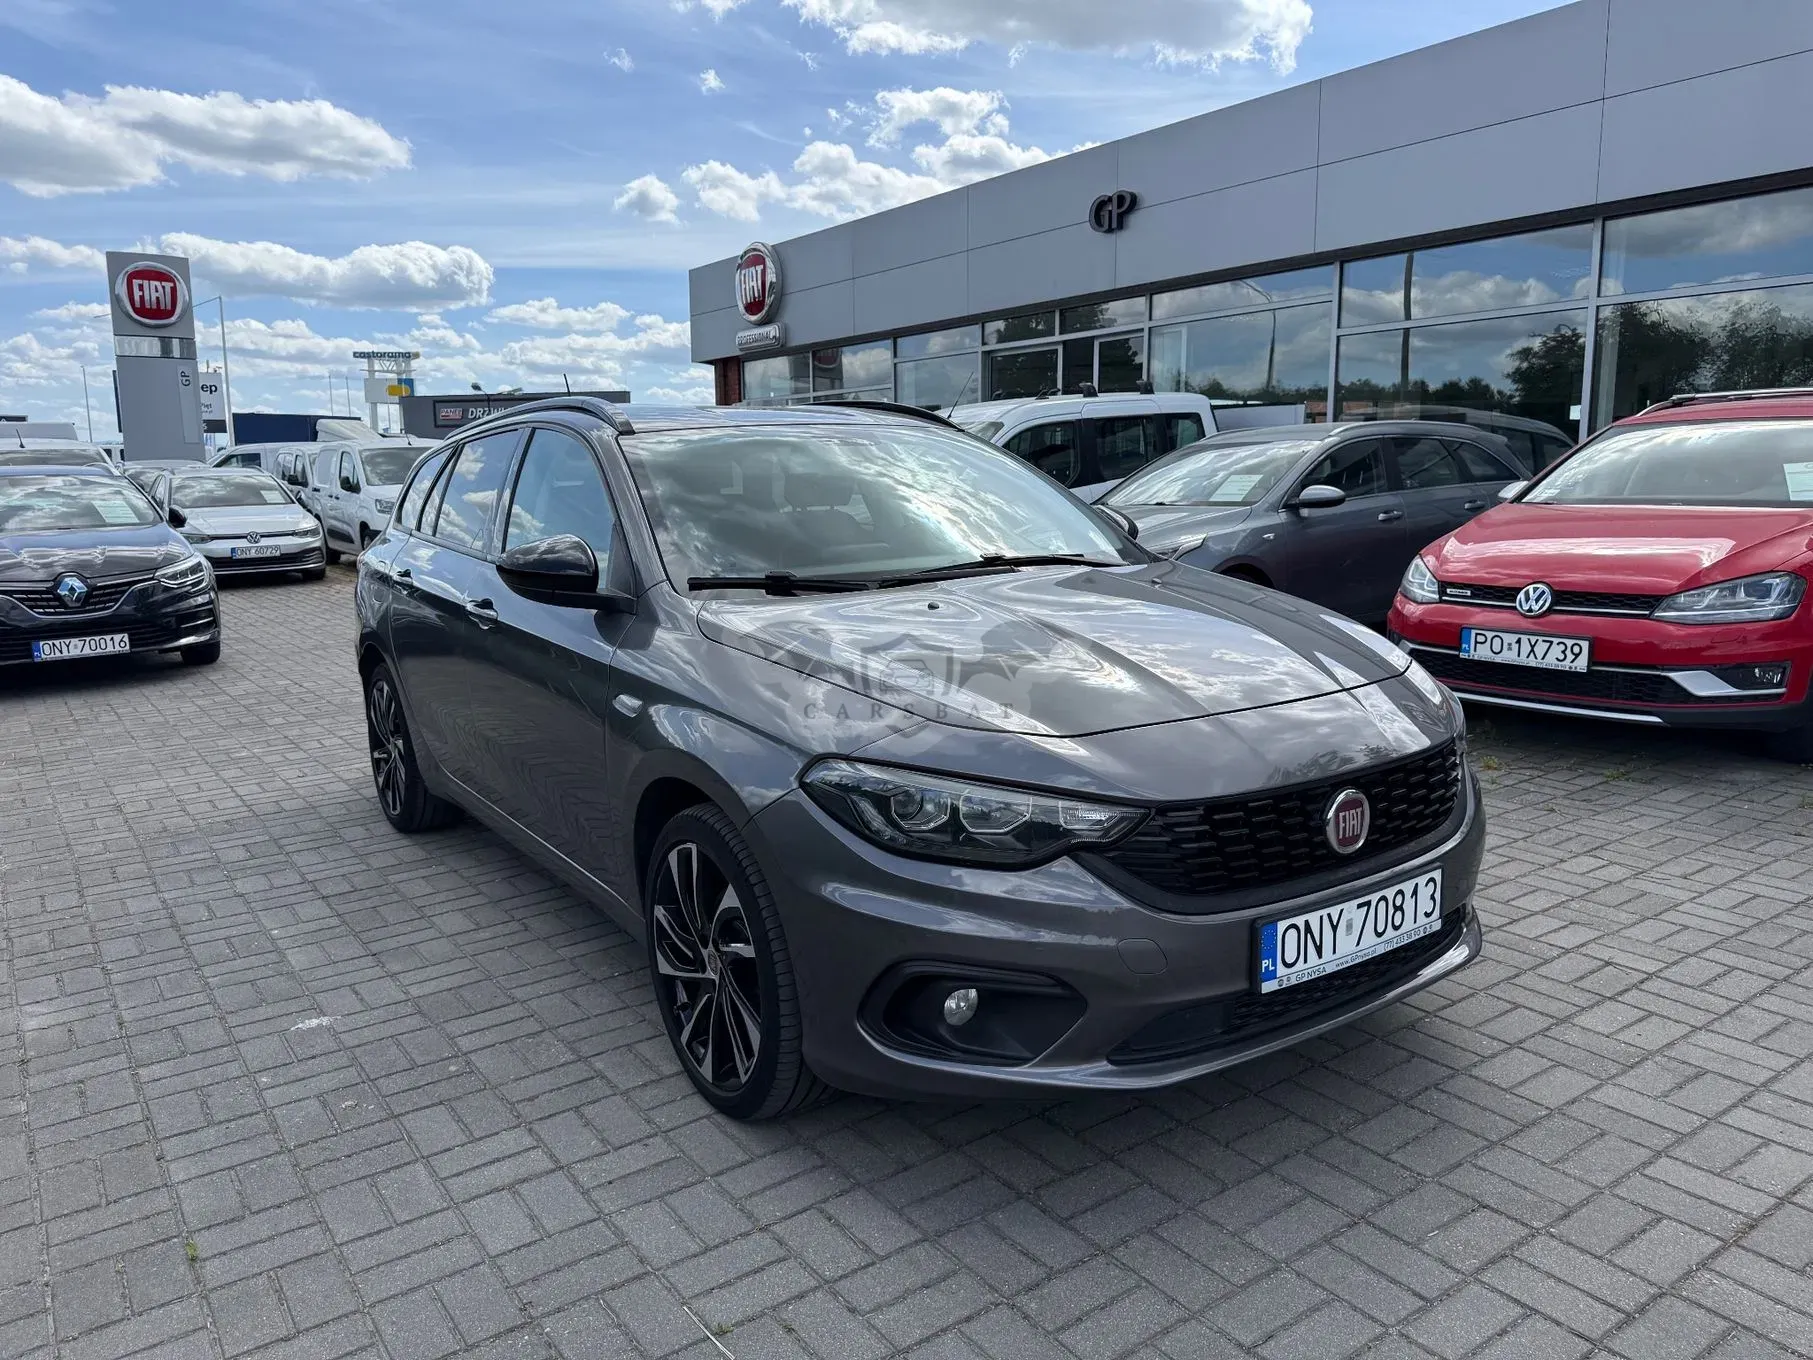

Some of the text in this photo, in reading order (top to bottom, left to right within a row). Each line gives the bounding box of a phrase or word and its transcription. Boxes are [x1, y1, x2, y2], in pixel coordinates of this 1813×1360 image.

[1089, 190, 1137, 233] GP
[132, 278, 174, 310] FIAT
[741, 265, 764, 304] FIAT
[353, 350, 412, 359] castorama
[180, 370, 191, 387] GP
[200, 383, 218, 395] ep
[237, 546, 279, 557] ONY 60729
[42, 640, 72, 656] ONY
[78, 635, 128, 653] 70016
[1474, 632, 1583, 664] PO 1X739
[1339, 807, 1362, 839] FIAT
[1280, 876, 1438, 969] ONY 70813
[1261, 958, 1275, 973] PL
[1295, 972, 1306, 982] GP
[1306, 966, 1327, 979] NYSA
